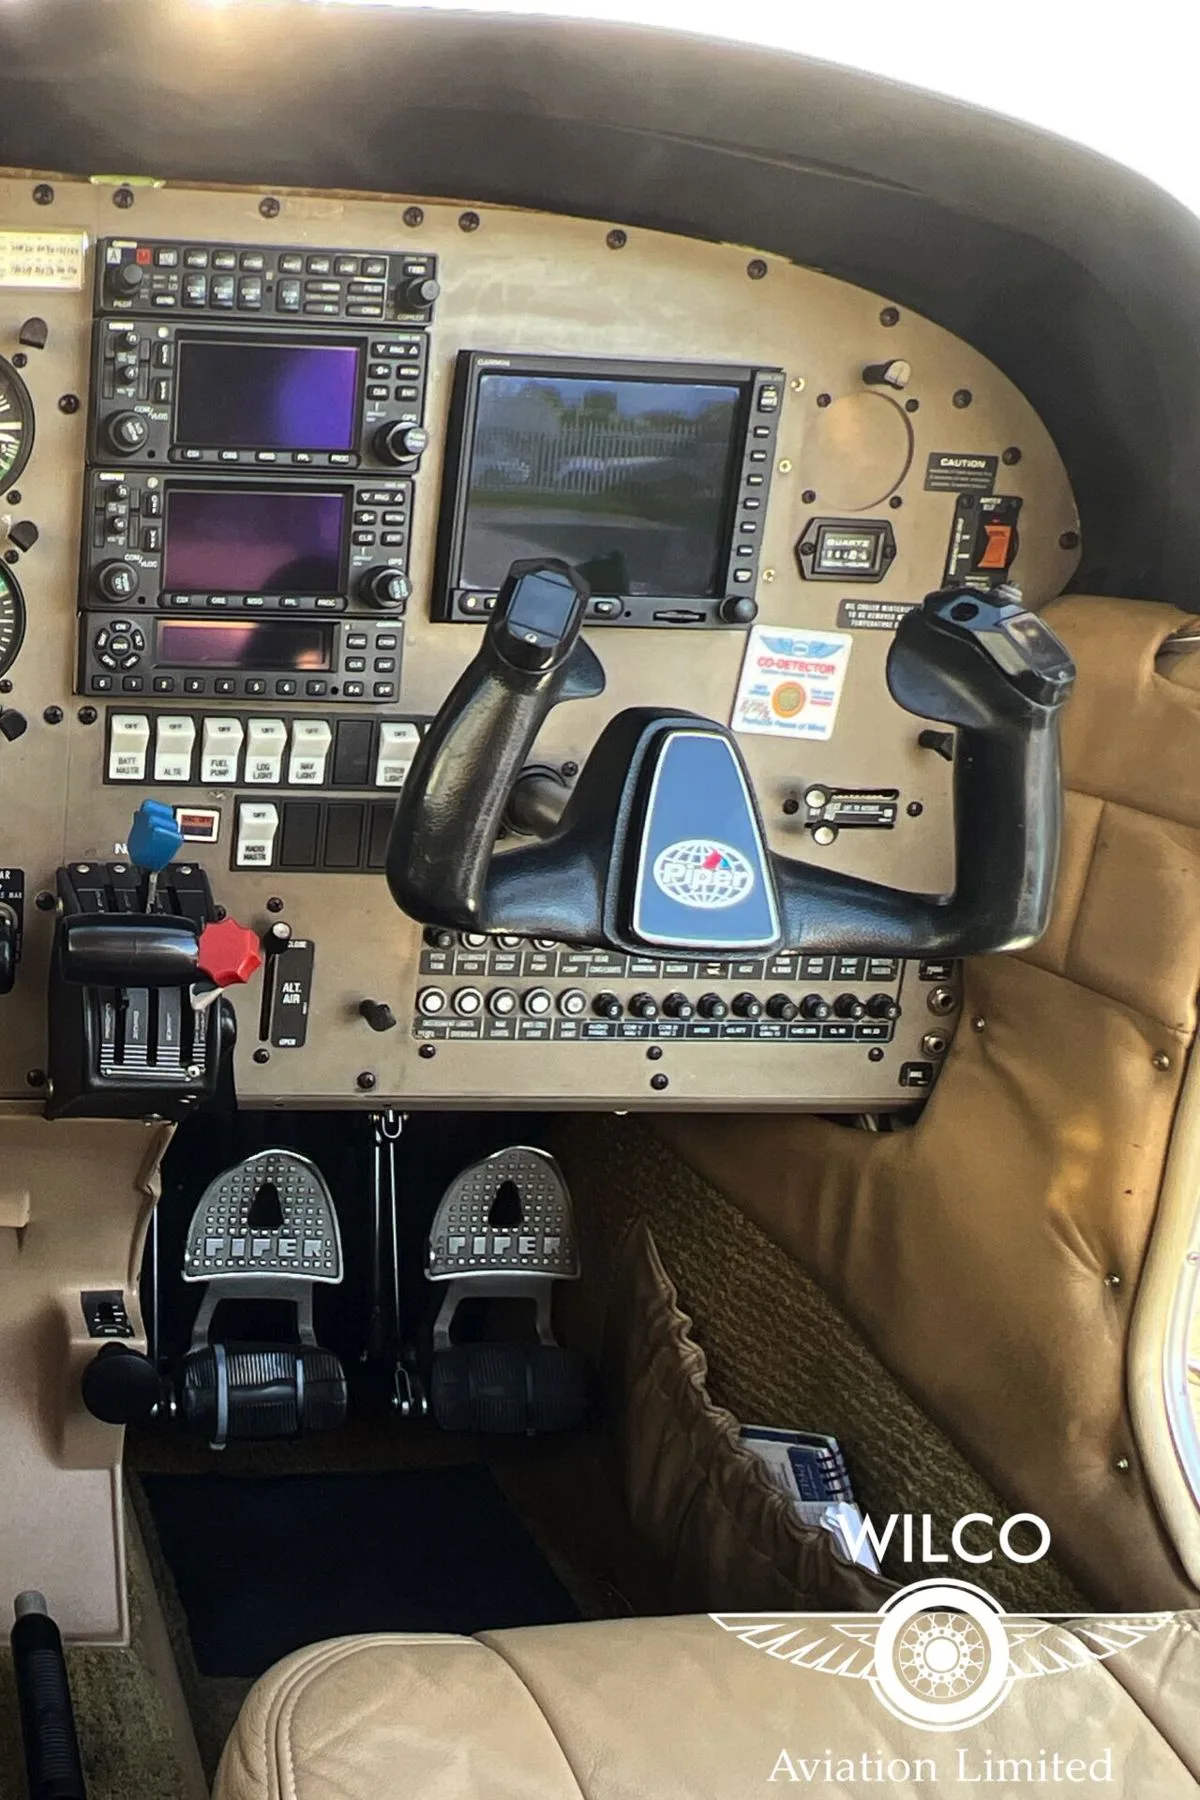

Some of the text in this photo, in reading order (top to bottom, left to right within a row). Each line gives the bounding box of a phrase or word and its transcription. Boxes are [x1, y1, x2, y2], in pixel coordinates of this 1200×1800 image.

[477, 358, 510, 366] GARMIN
[940, 458, 986, 468] CAUTION
[757, 657, 835, 674] CO-DETECTOR
[117, 757, 136, 765] BATT
[210, 759, 228, 767] FUEL
[115, 766, 139, 775] MASTR
[300, 762, 314, 770] NAV
[163, 768, 181, 776] ALTR
[209, 768, 229, 777] PUMP
[252, 771, 272, 780] LIGHT
[295, 771, 316, 779] LIGHT
[243, 853, 266, 862] MASTR
[663, 863, 749, 892] Piper
[282, 982, 301, 993] ALT.
[282, 993, 300, 1004] AIR
[204, 1237, 322, 1257] PIPER
[448, 1236, 560, 1256] PIPER
